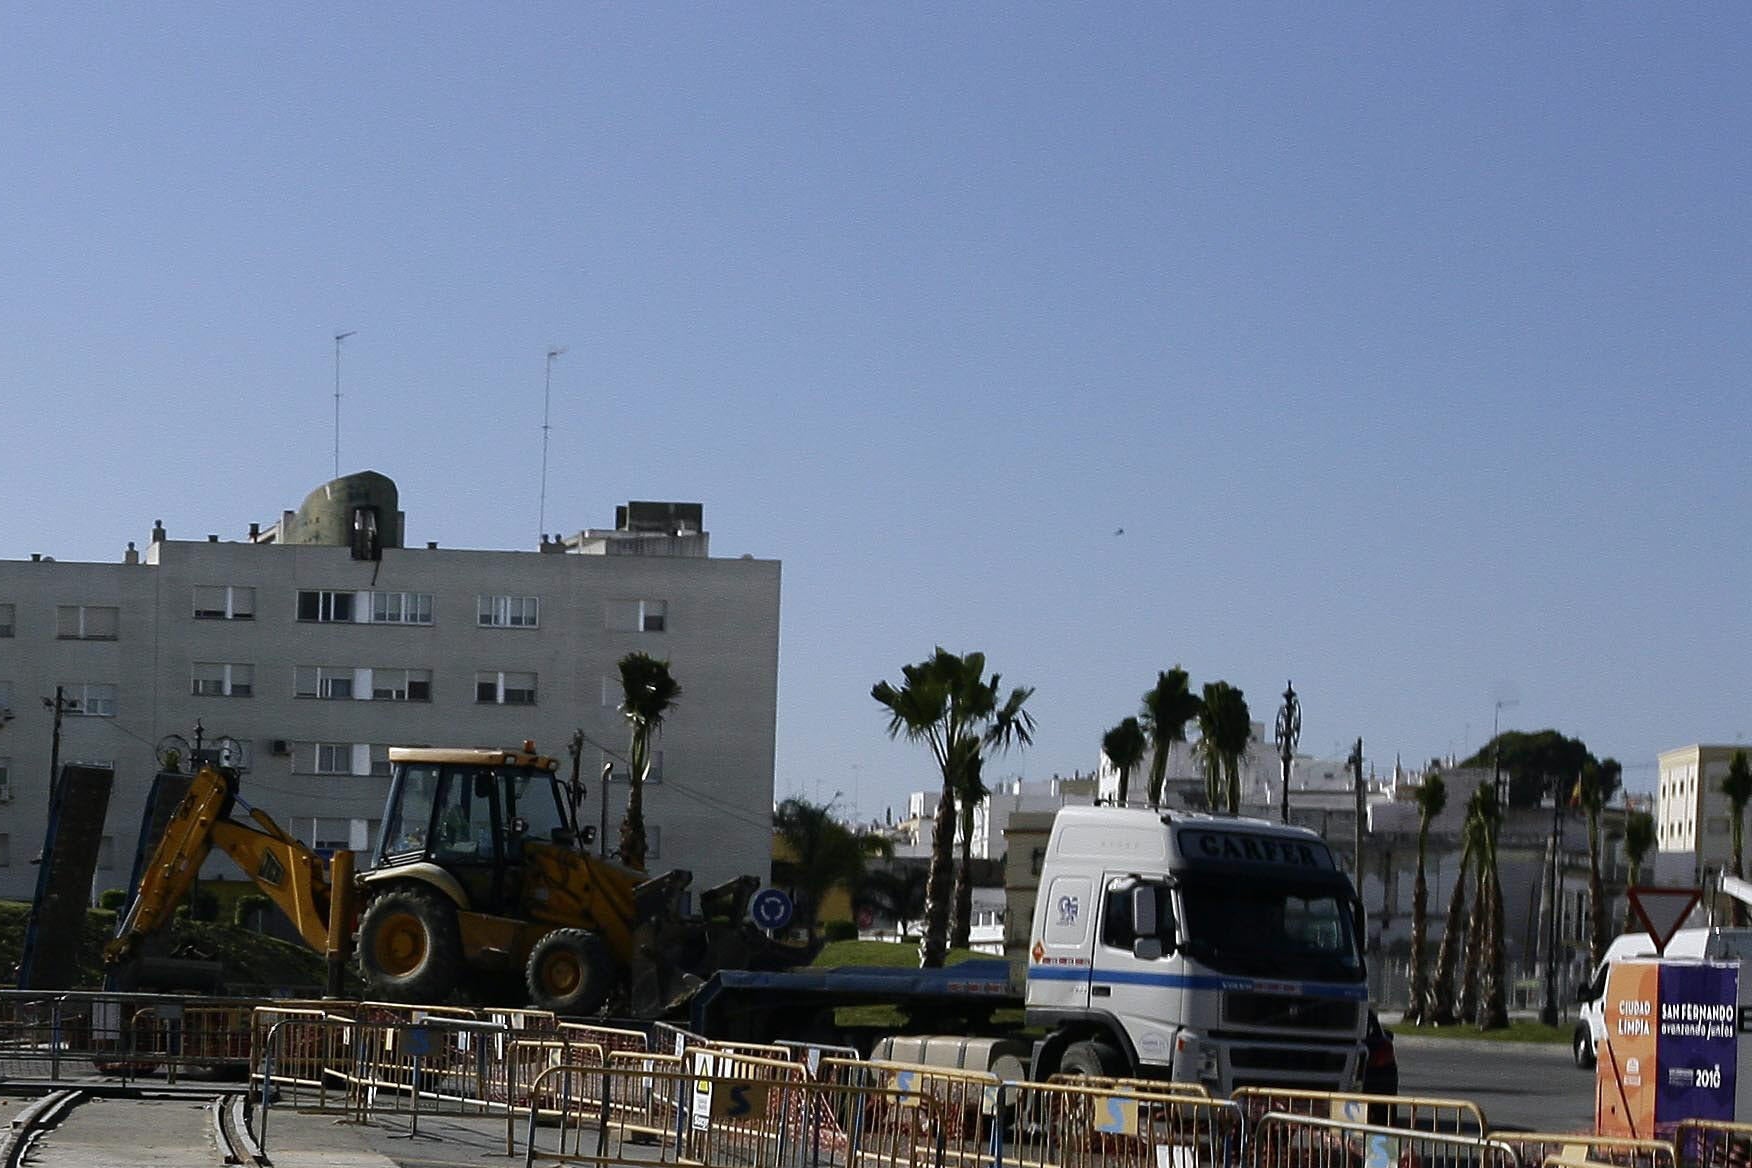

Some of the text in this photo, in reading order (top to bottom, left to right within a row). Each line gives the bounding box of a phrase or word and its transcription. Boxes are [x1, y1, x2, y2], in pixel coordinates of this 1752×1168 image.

[1619, 1000, 1651, 1016] CIUDAD
[1662, 1003, 1734, 1023] SAN FERNANDO
[1618, 1019, 1650, 1036] LIMPIA
